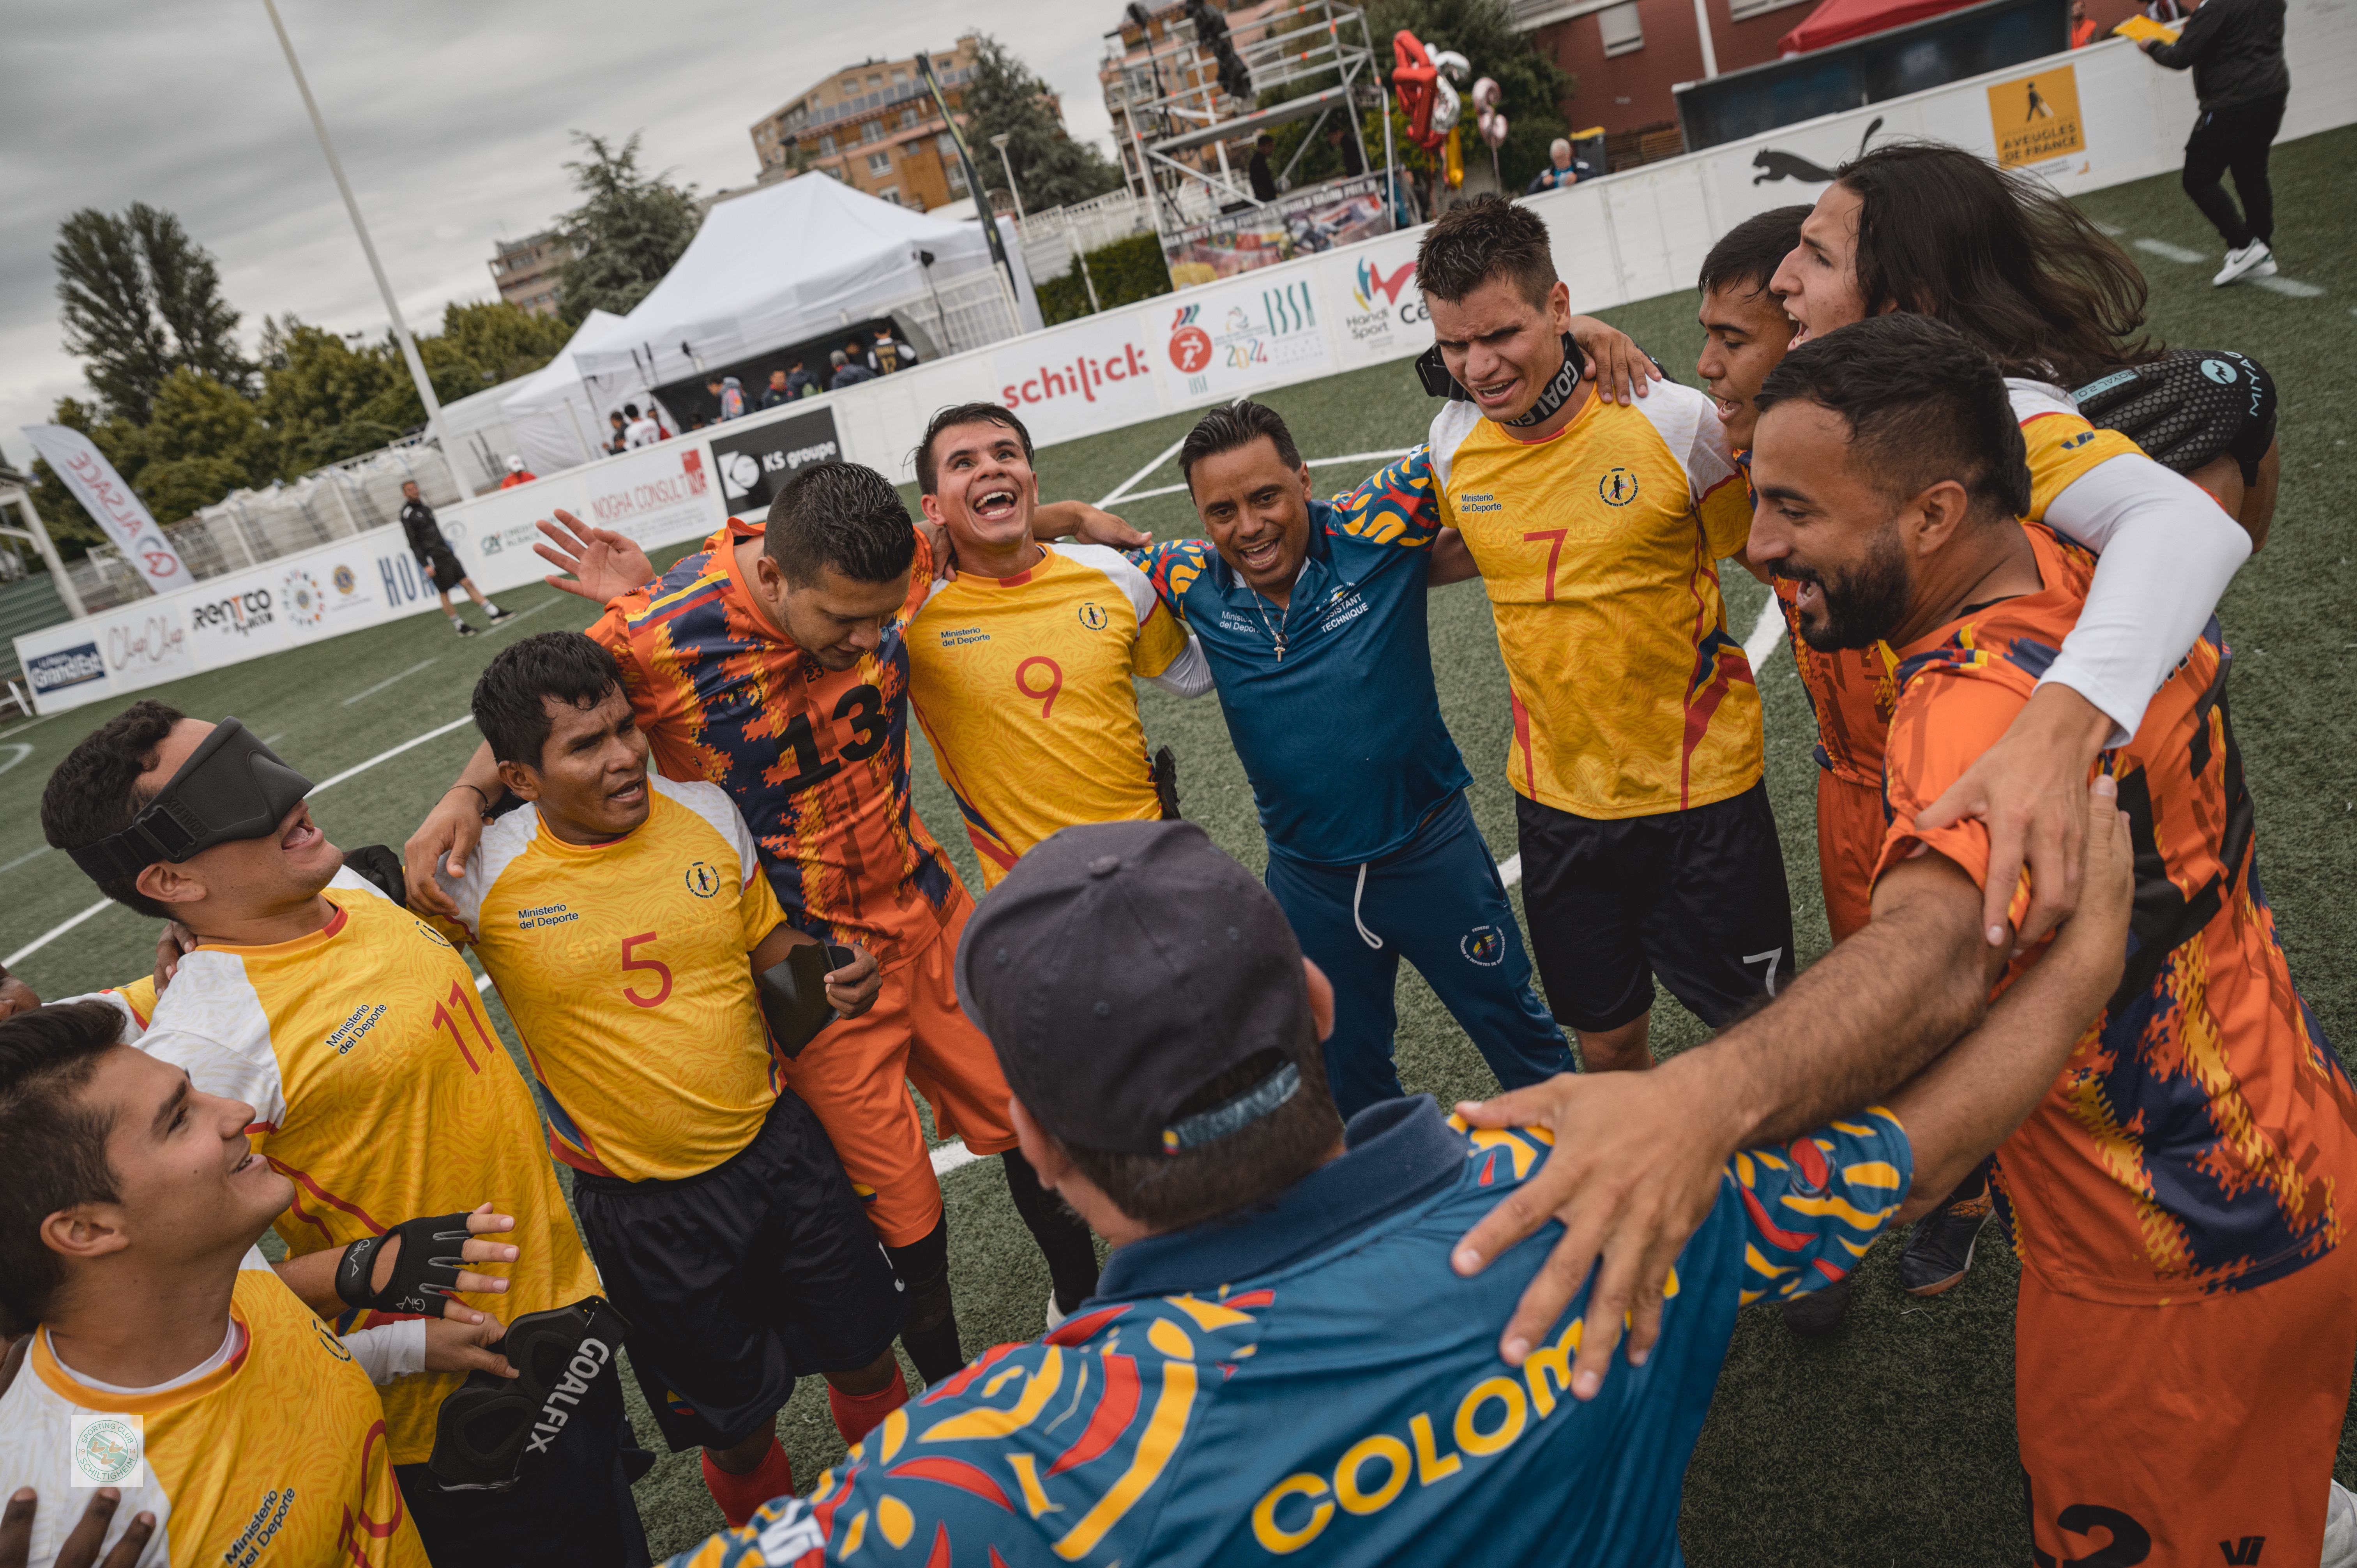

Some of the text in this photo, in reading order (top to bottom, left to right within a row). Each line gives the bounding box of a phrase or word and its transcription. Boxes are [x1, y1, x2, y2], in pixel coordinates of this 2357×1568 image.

[2004, 122, 2076, 150] AVEUGLES
[2025, 135, 2078, 157] FRANCE
[1224, 338, 1268, 370] 2024
[762, 441, 836, 473] KS groupe
[1461, 493, 1493, 502] Ministerio
[1461, 502, 1502, 513] del Deporte
[1523, 528, 1569, 602] 7
[941, 627, 981, 638] Ministerio
[1219, 621, 1232, 630] del
[1321, 602, 1369, 633] TECHNIQUE
[942, 633, 990, 646] del Deporte
[1015, 656, 1063, 719] 9
[774, 684, 888, 796] 13
[518, 904, 566, 919] Ministerio
[519, 912, 579, 929] del Deporte
[622, 931, 673, 1008] 5
[1743, 947, 1782, 998] 7
[325, 1004, 369, 1047] Ministerio
[338, 1004, 387, 1055] del Deporte
[432, 978, 495, 1075] 11
[525, 1338, 610, 1453] GOALFIX
[1252, 1266, 1680, 1554] COLOM
[337, 1419, 403, 1568] 10
[224, 1490, 278, 1564] Ministerio
[257, 1487, 295, 1547] Deporte
